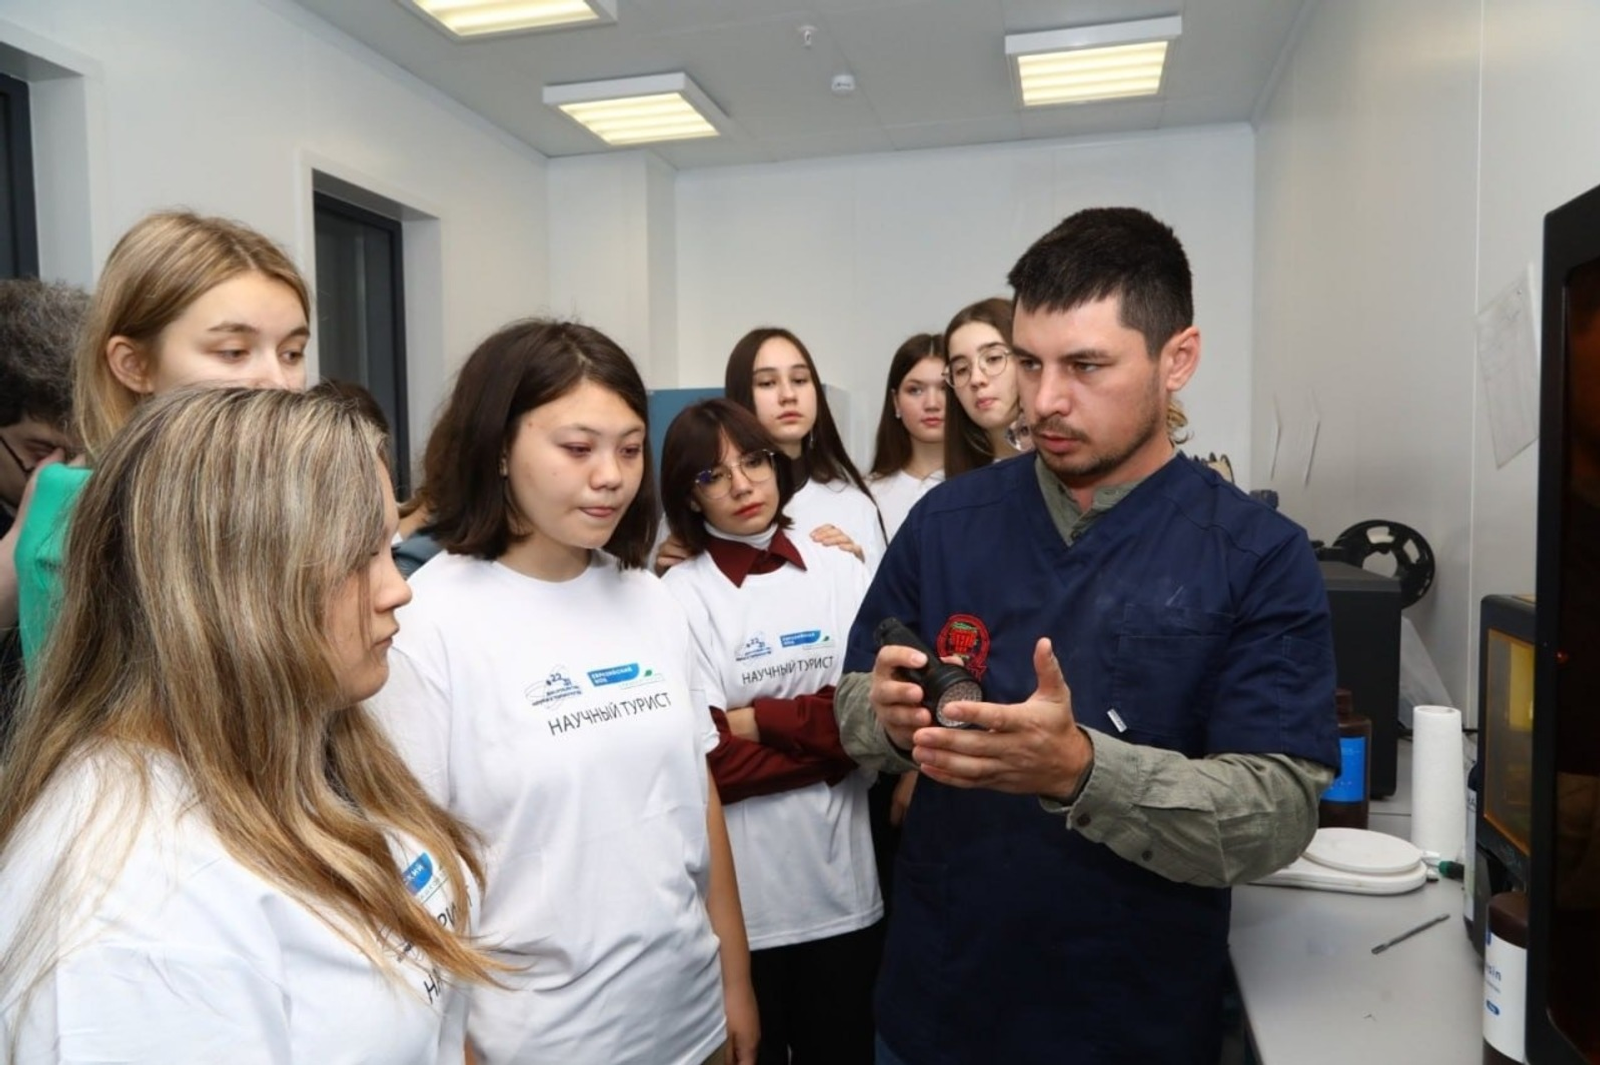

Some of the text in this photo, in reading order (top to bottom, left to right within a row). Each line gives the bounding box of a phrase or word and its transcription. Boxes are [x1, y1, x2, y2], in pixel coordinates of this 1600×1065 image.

[741, 656, 834, 684] НАУЧНЫЙ ТУРИСТ
[548, 692, 672, 736] НАУЧНЫЙ ТУРИСТ
